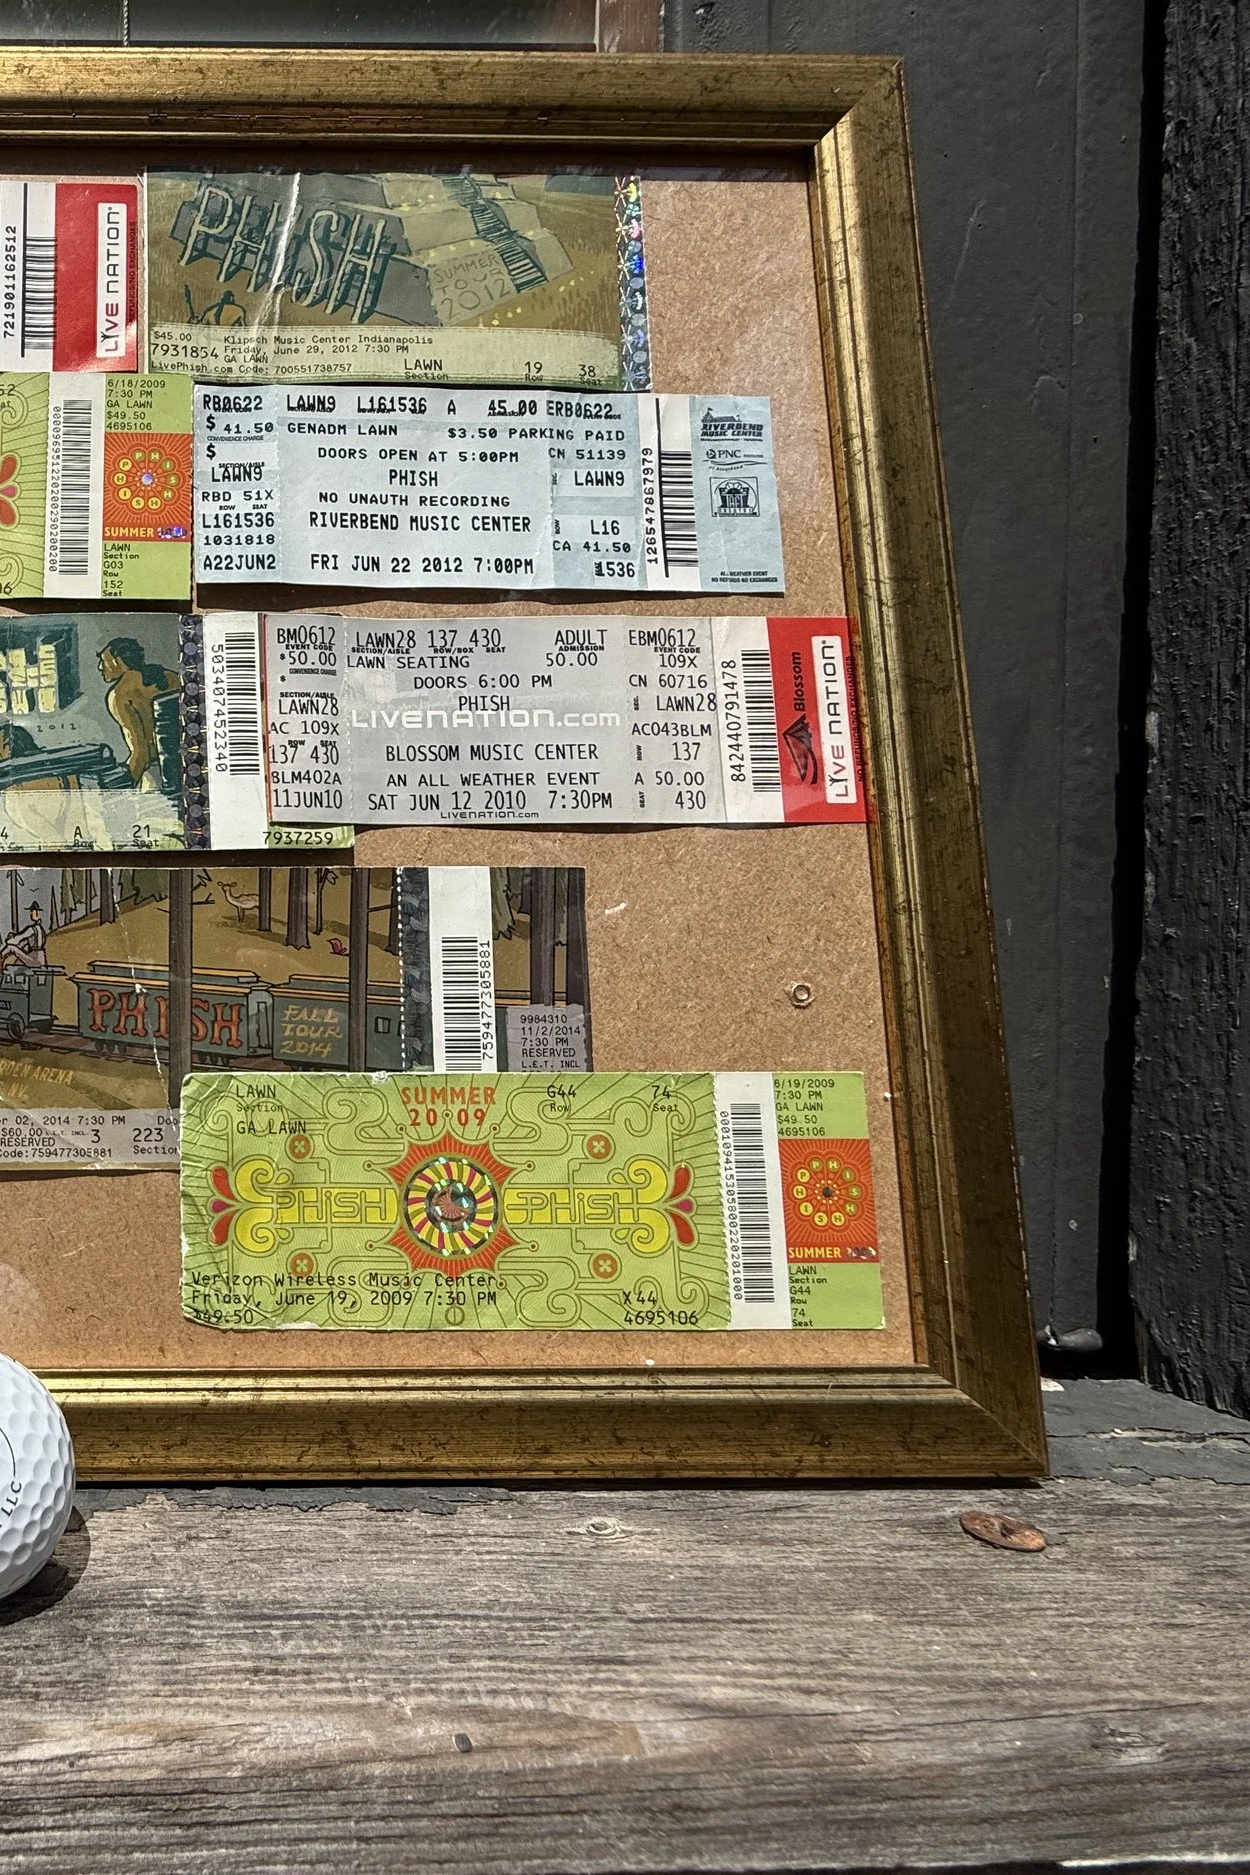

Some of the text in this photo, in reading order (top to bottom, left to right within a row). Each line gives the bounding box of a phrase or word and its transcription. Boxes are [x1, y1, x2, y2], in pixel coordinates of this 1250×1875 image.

[274, 335, 305, 344] Music
[312, 335, 350, 343] Center
[358, 335, 433, 345] Indianapolis
[152, 343, 219, 358] 7931854
[274, 345, 299, 354] June
[307, 345, 324, 355] 29,
[332, 345, 358, 353] 2012
[366, 345, 390, 353] 7:30
[404, 359, 596, 377] LAWN 19 38
[108, 380, 166, 388] 6/18/2009
[108, 390, 153, 398] 7:30 PM
[288, 423, 397, 435] GENADM LAWN
[389, 470, 438, 486] PHISH
[574, 471, 624, 486] LAWN9
[310, 512, 531, 533] RIVERBEND MUSIC CENTER
[105, 527, 154, 536] SUMMER
[311, 555, 534, 574] FRI JUN 22 2012 7:00PM
[277, 626, 336, 645] BM0612
[356, 628, 607, 648] LAWN28 137 430 ADULT
[629, 629, 696, 646] EBM0612
[414, 674, 552, 688] DOORS 6:00 PM
[791, 652, 806, 712] Blossom
[458, 696, 510, 711] PHISH
[386, 744, 598, 762] BLOSSOM MUSIC CENTER
[368, 790, 612, 810] SAT JUN 12 2010 7:30PM
[133, 825, 151, 838] 21
[263, 832, 333, 845] 7937259
[522, 1026, 581, 1036] 11/2/2014
[522, 1048, 575, 1057] RESERVED
[774, 1079, 835, 1088] 6/19/2009
[236, 1085, 276, 1097] LAWN
[402, 1087, 496, 1105] SUMMER
[547, 1086, 670, 1099] G44 74
[16, 1116, 35, 1127] 02,
[43, 1116, 70, 1125] 2014
[77, 1116, 104, 1125] 7:30
[112, 1116, 125, 1124] PM
[133, 1129, 164, 1142] 223
[192, 1272, 497, 1286] Verizon Wireless Music Center
[276, 1292, 497, 1307] June 19, 2009 7:30 PM
[625, 1311, 699, 1325] 4695106
[3, 1481, 22, 1517] LLC
